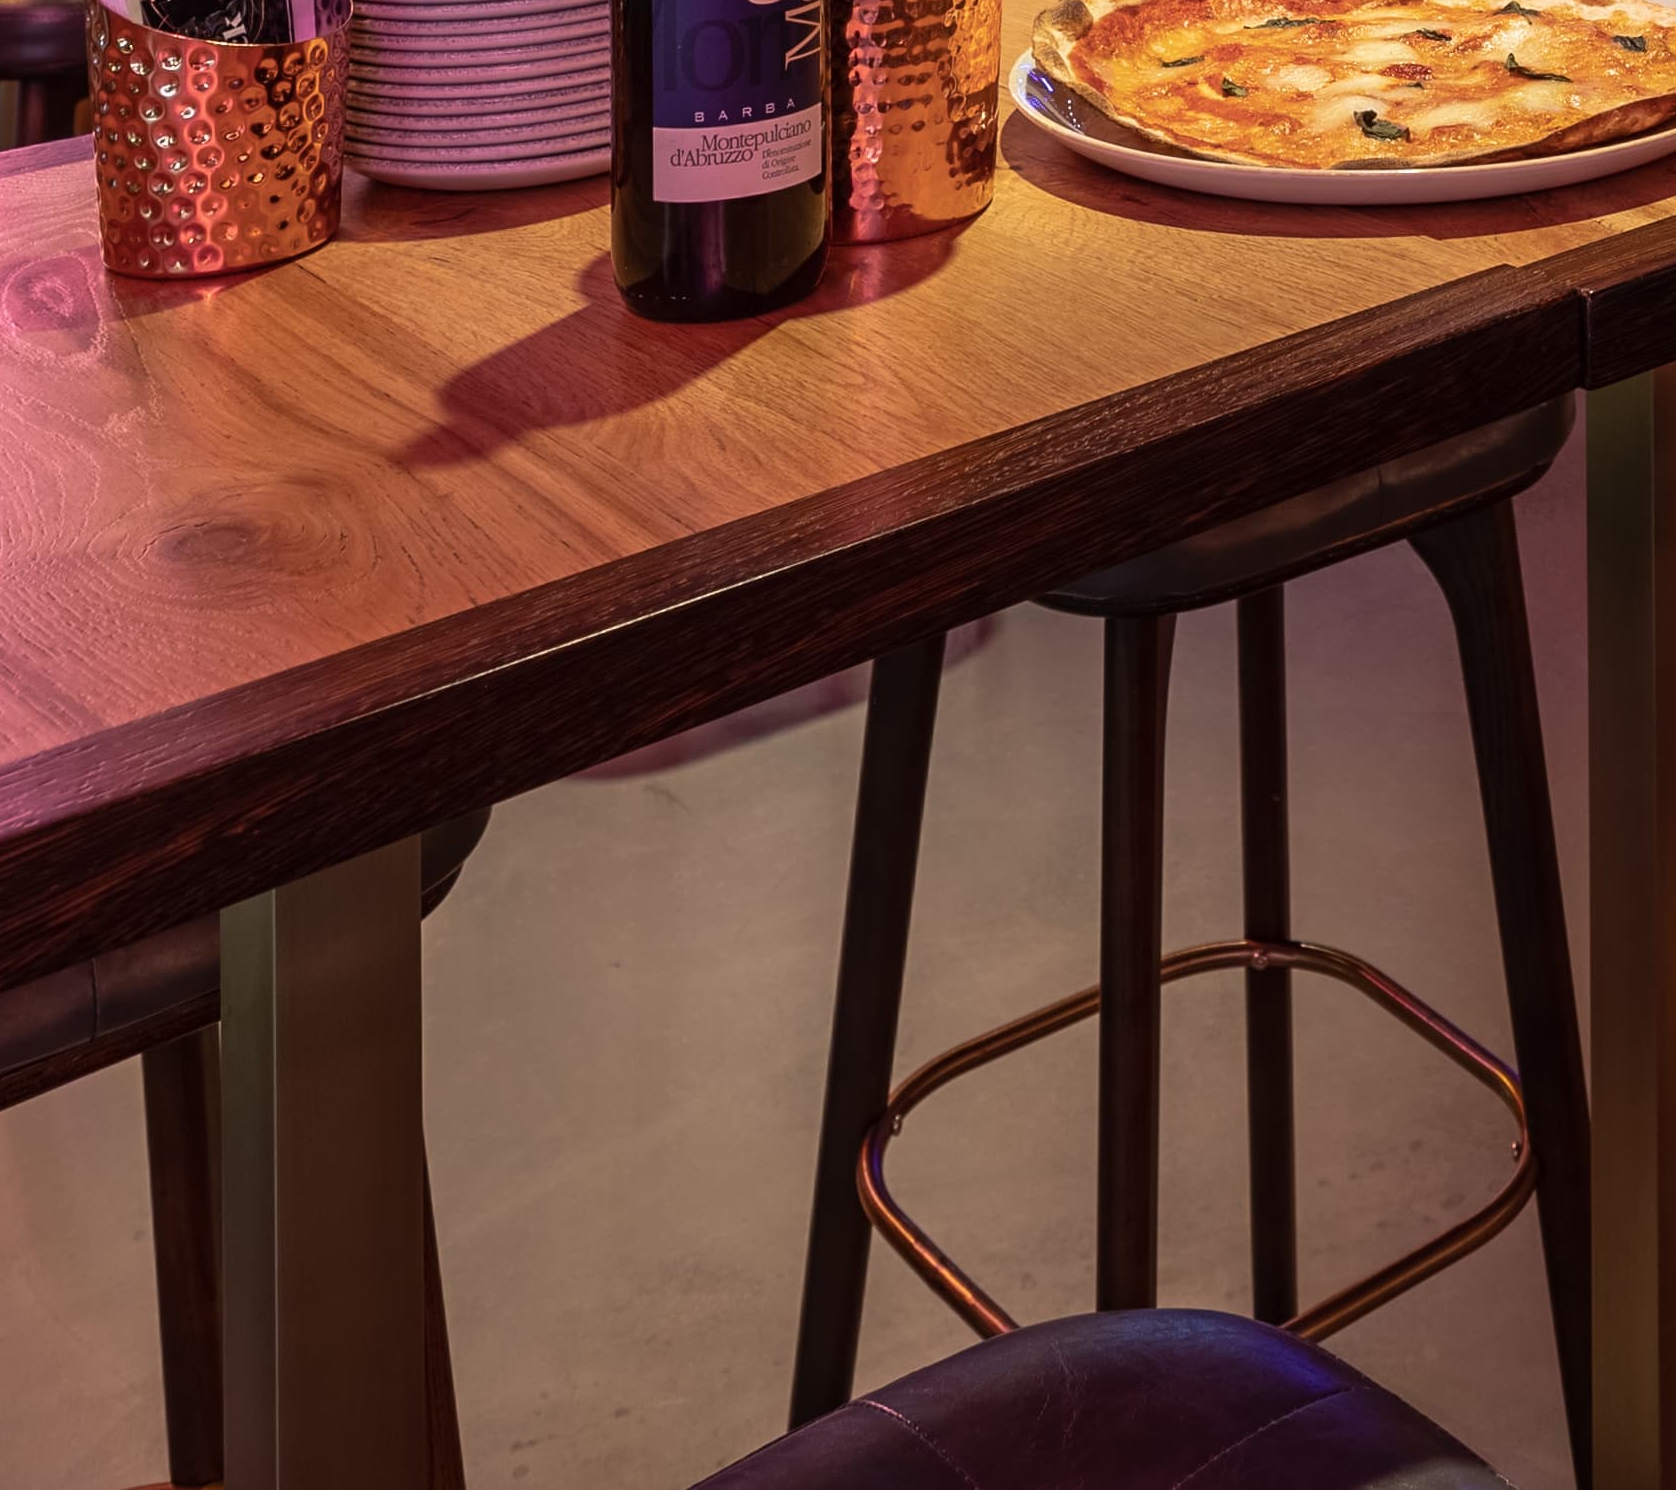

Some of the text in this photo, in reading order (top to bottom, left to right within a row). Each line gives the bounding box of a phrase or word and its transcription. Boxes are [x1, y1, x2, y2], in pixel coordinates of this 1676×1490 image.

[694, 98, 796, 122] BARBA
[701, 119, 812, 152] Montepulciano
[670, 148, 754, 167] d'Abruzzo
